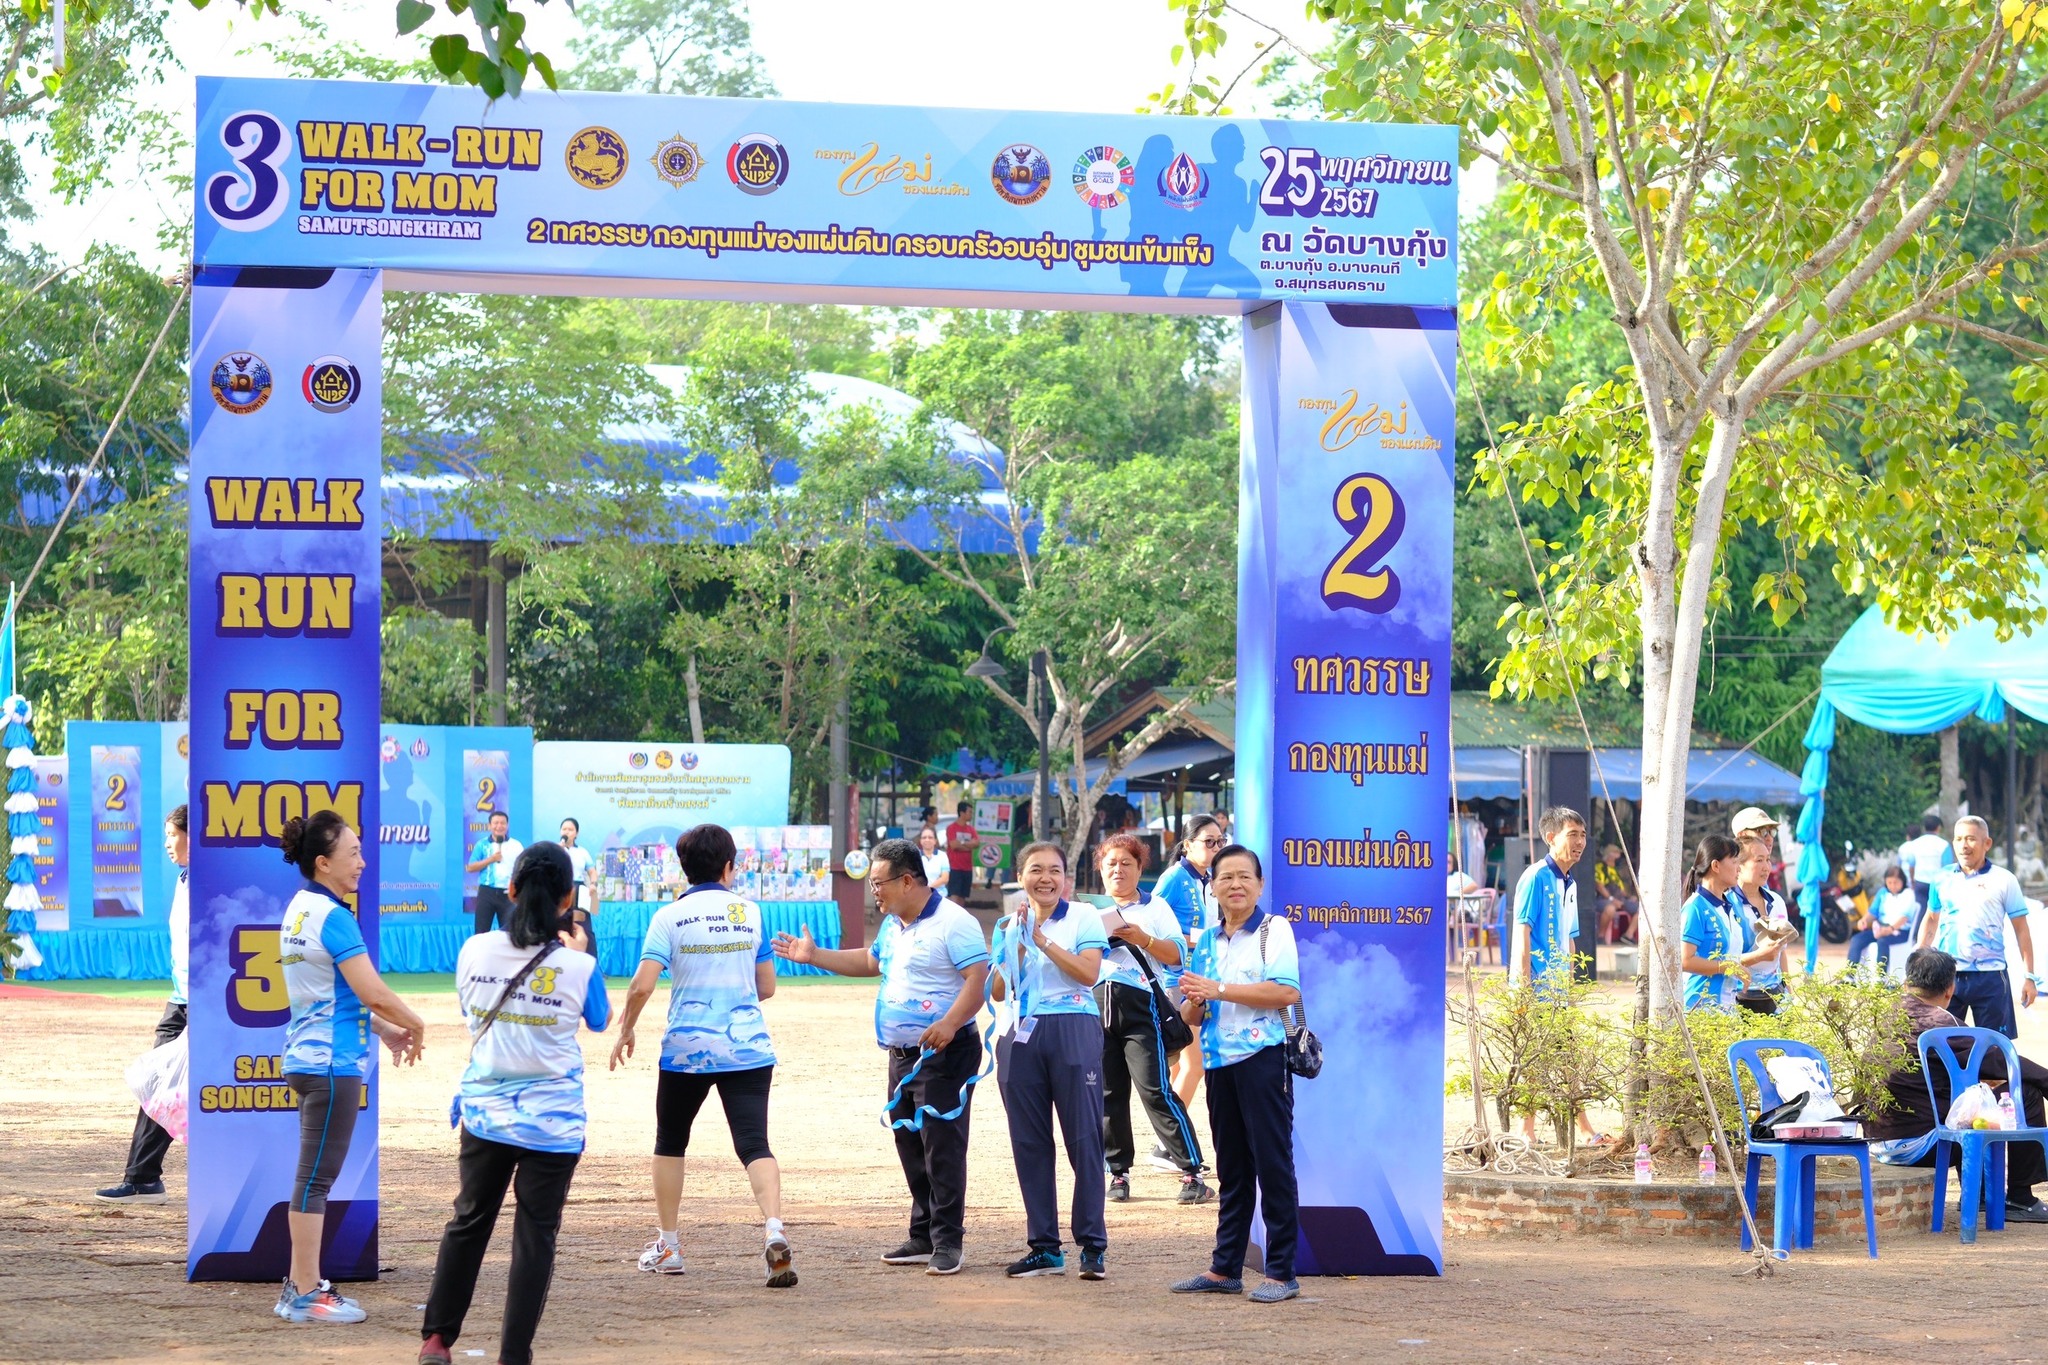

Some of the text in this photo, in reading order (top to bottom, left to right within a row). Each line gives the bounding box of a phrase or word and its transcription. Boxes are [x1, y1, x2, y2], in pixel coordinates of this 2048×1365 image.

[207, 110, 286, 224] 3
[814, 149, 856, 164] กองทุน
[1320, 154, 1450, 185] พฤศจิกายน
[303, 172, 497, 215] FOR MOM
[1260, 147, 1319, 213] 25
[1320, 188, 1377, 215] 2567
[298, 216, 481, 240] SAMUTSONGKHRAM
[528, 218, 1214, 270] 2 ทศวรรษ กองทุนแม่ของแผ่นดิน ครอบครัวอบอุ่น ชุมชนเข้มแข็ง
[1261, 227, 1447, 267] ณ วัดบางกุ้ง
[1260, 259, 1400, 275] ต.บางกุ้ง อ.บางคนที
[1274, 278, 1385, 293] จ.สมุทรสงคราม
[1298, 398, 1336, 414] กองทุน
[1380, 430, 1442, 450] ของแผ่นดิน
[206, 478, 363, 527] WALK
[1321, 473, 1401, 610] 2
[217, 574, 354, 635] RUN
[1293, 655, 1431, 695] ทศวรรษ
[226, 690, 341, 748] FOR
[1289, 733, 1428, 785] กองทุนแม่
[106, 774, 127, 811] 2
[476, 777, 496, 812] 2
[40, 817, 54, 826] UN
[203, 782, 362, 843] MOM
[1284, 829, 1432, 868] ของแผ่นดิน
[727, 903, 747, 924] 3
[1285, 902, 1432, 928] 25 พฤศจิกายน 2567
[530, 966, 556, 995] 3
[511, 991, 562, 1007] OR MOM
